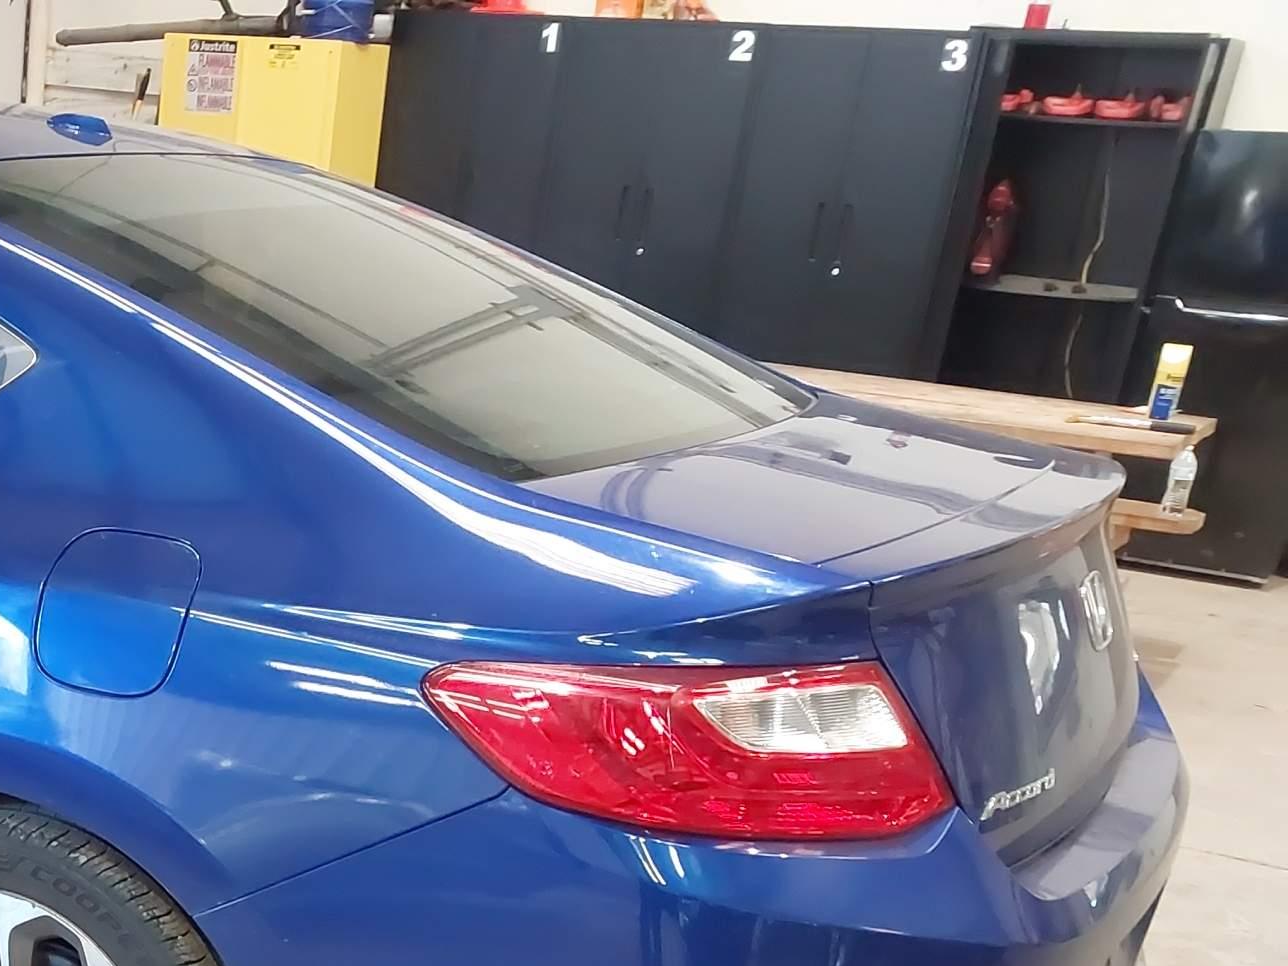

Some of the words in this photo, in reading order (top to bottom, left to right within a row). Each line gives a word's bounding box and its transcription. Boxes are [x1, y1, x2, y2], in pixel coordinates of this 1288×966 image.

[542, 22, 559, 53] 1
[728, 30, 755, 61] 2
[941, 39, 968, 71] 3
[980, 767, 1056, 821] Accord
